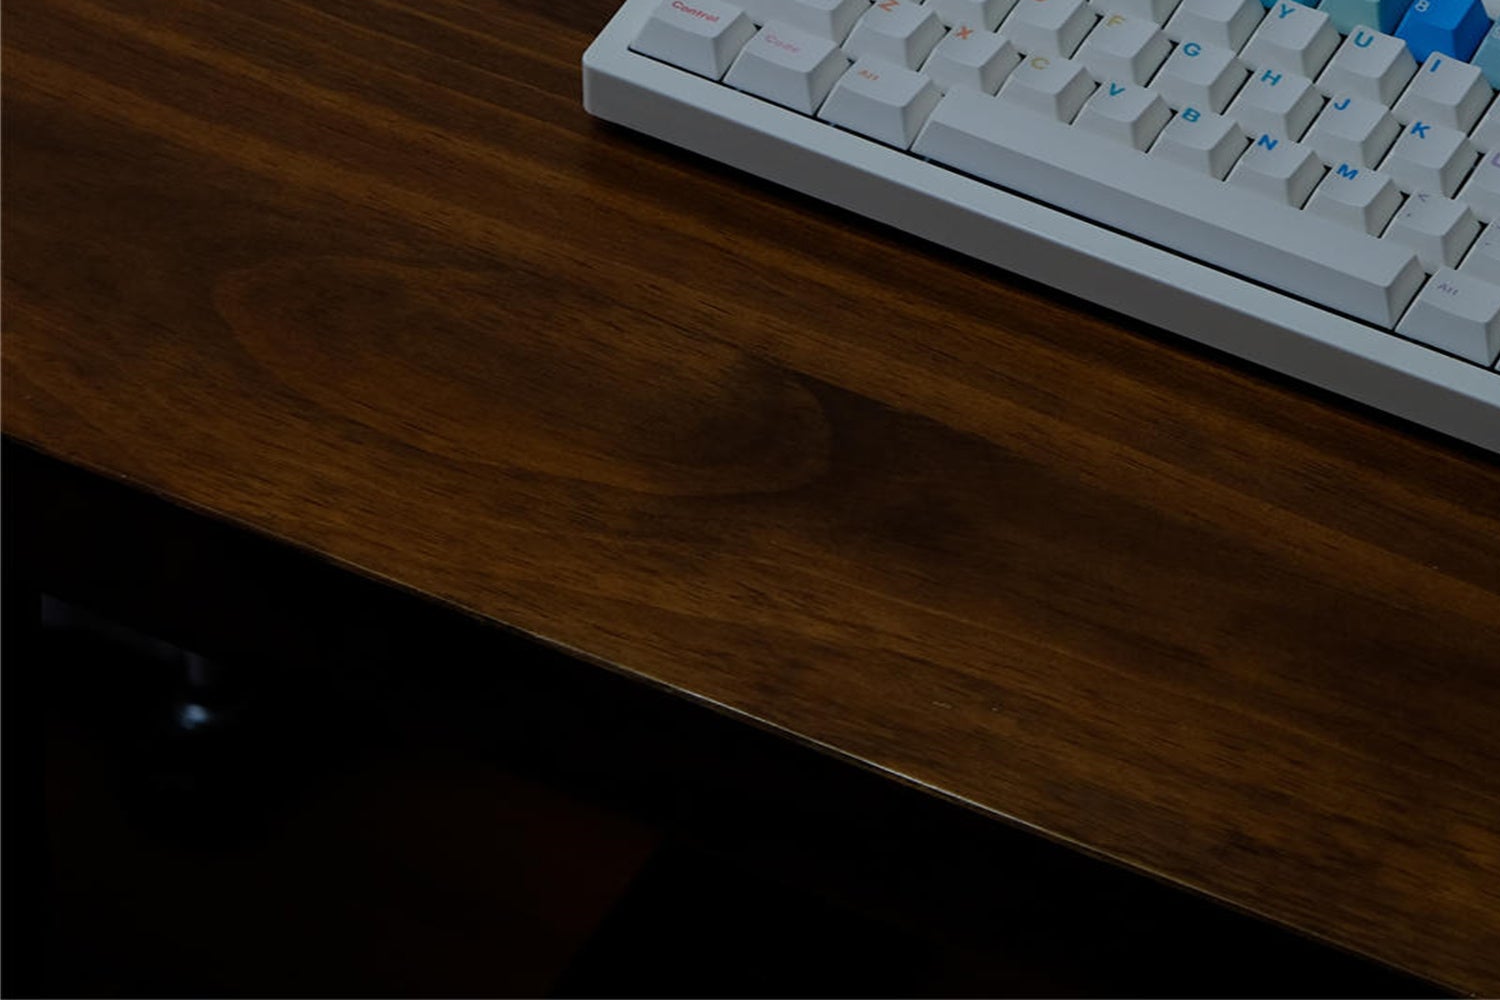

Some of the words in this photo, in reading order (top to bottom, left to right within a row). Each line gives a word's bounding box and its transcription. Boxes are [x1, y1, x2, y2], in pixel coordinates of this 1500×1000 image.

[671, 0, 720, 23] Control
[1280, 3, 1295, 20] Y
[1107, 14, 1125, 28] F
[956, 26, 974, 40] X
[1354, 31, 1374, 48] U
[1183, 42, 1202, 57] G
[1030, 56, 1049, 70] C
[1262, 69, 1282, 86] H
[1109, 82, 1126, 97] V
[1334, 98, 1352, 111] J
[1181, 107, 1200, 123] B
[1411, 121, 1430, 138] K
[1257, 134, 1278, 150] N
[1336, 163, 1358, 180] M
